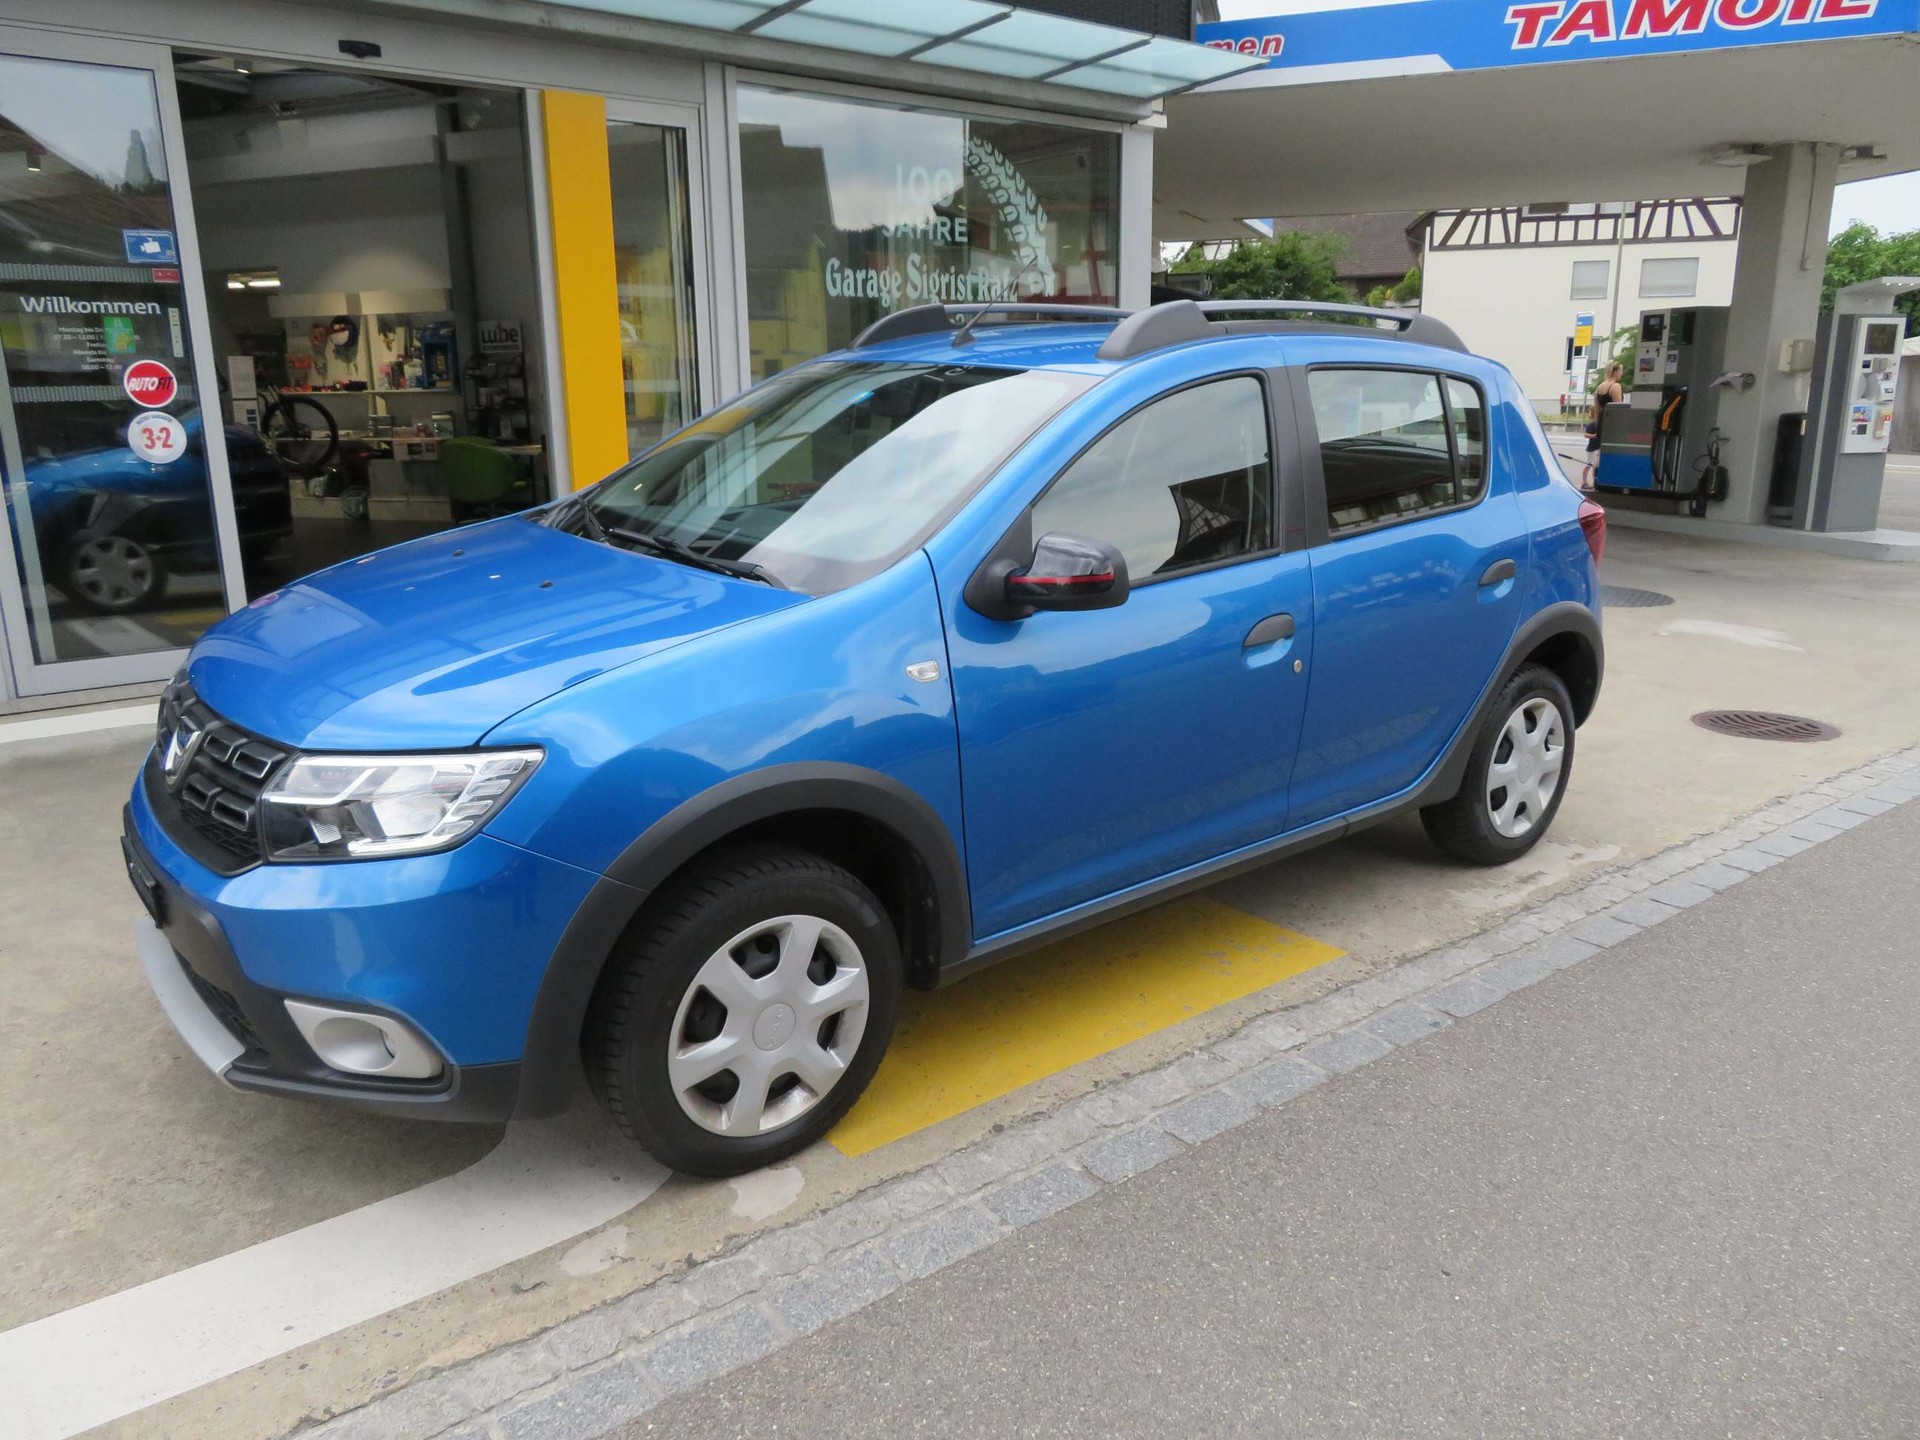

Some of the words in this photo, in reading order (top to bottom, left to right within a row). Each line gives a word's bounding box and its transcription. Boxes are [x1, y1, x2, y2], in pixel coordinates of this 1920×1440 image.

[896, 163, 956, 207] 100
[882, 216, 968, 243] JAHRE
[825, 257, 902, 307] Garage
[906, 253, 974, 304] Sigrist
[20, 296, 162, 315] Willkommen
